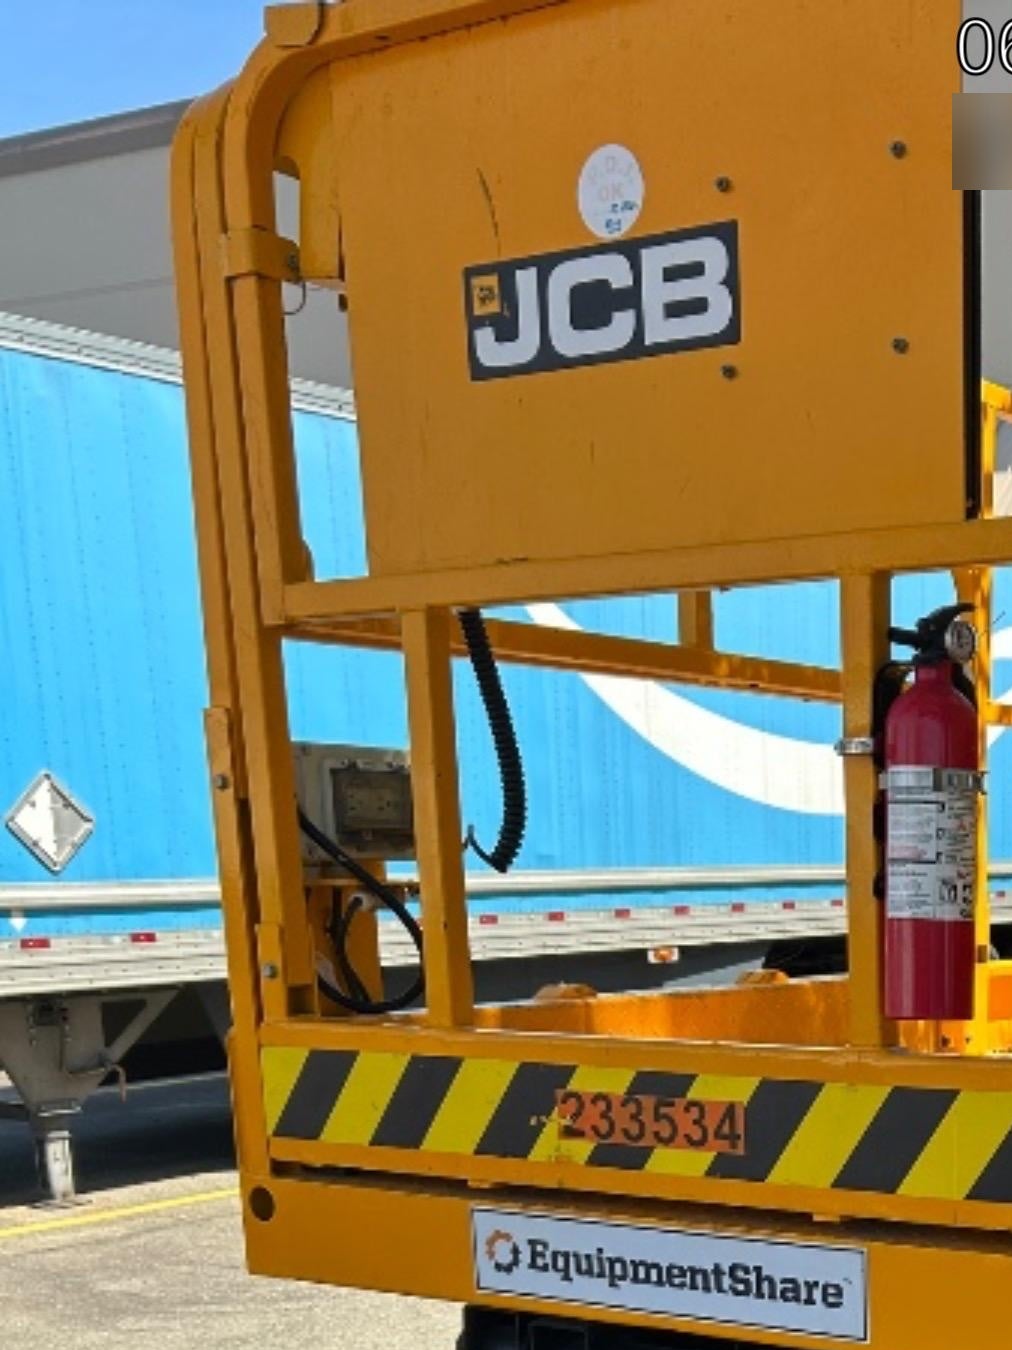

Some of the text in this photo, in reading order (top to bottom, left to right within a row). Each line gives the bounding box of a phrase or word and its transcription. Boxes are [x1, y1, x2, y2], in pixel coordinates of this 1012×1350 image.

[474, 236, 733, 368] JCB
[557, 1090, 743, 1150] 233534
[526, 1238, 844, 1309] EquipmentShare
